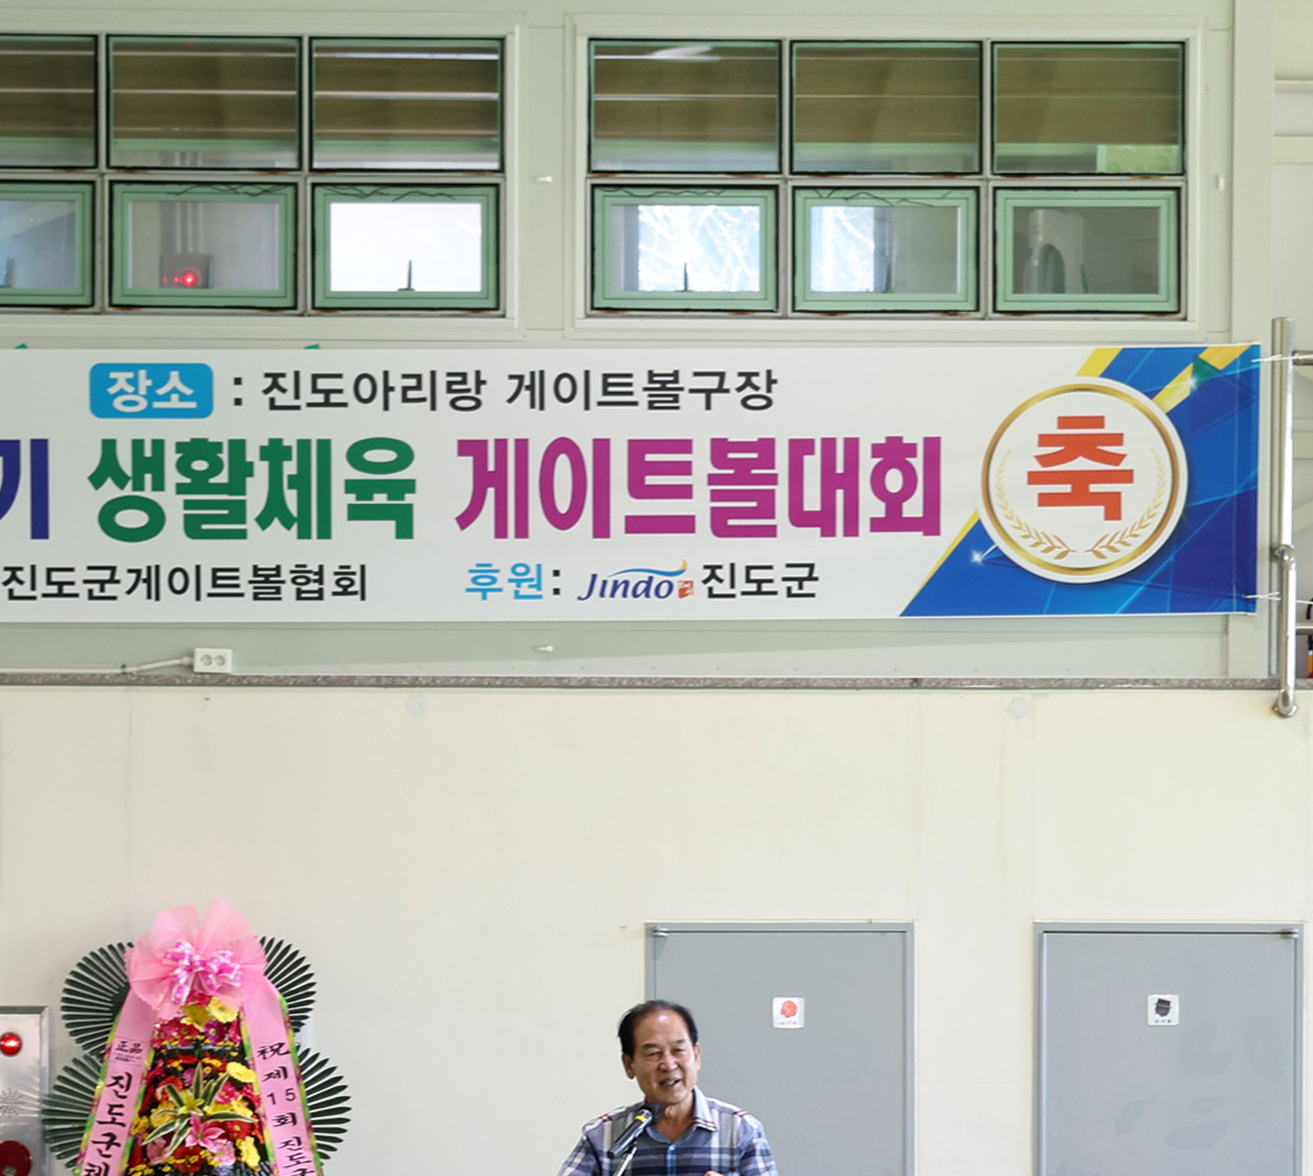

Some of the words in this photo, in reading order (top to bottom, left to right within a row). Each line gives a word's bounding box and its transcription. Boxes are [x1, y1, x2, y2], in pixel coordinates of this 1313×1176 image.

[107, 369, 198, 413] 장소
[261, 369, 488, 413] 진도아리랑
[505, 368, 779, 412] 게이트볼구장
[87, 436, 417, 543] 생활체육
[455, 435, 942, 540] 게이트볼대회
[1027, 415, 1135, 521] 축
[1, 563, 368, 602] 진도군게이트볼협회
[465, 562, 561, 600] 후원:
[576, 573, 675, 602] Jindo
[700, 562, 820, 600] 진도군
